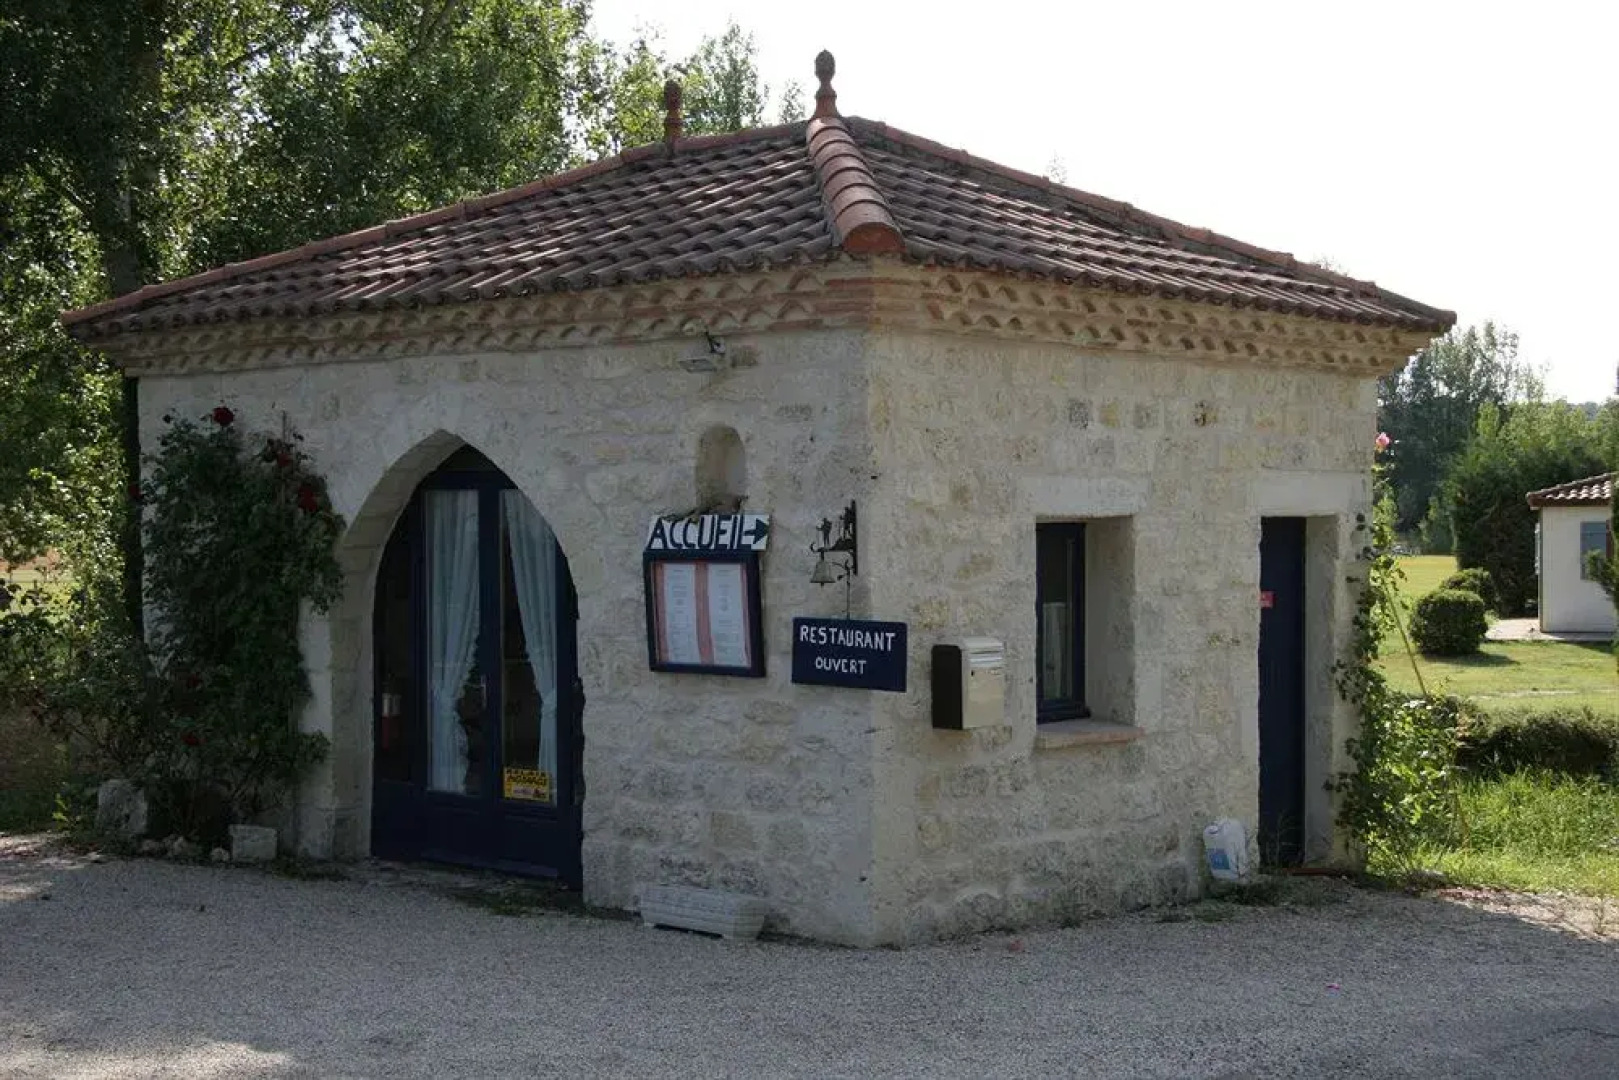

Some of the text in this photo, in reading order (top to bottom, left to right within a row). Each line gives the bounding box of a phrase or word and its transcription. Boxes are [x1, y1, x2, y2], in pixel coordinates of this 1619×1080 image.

[646, 514, 752, 549] ACCUEIL
[800, 625, 895, 651] RESTAURANT
[815, 657, 867, 674] OUVERT
